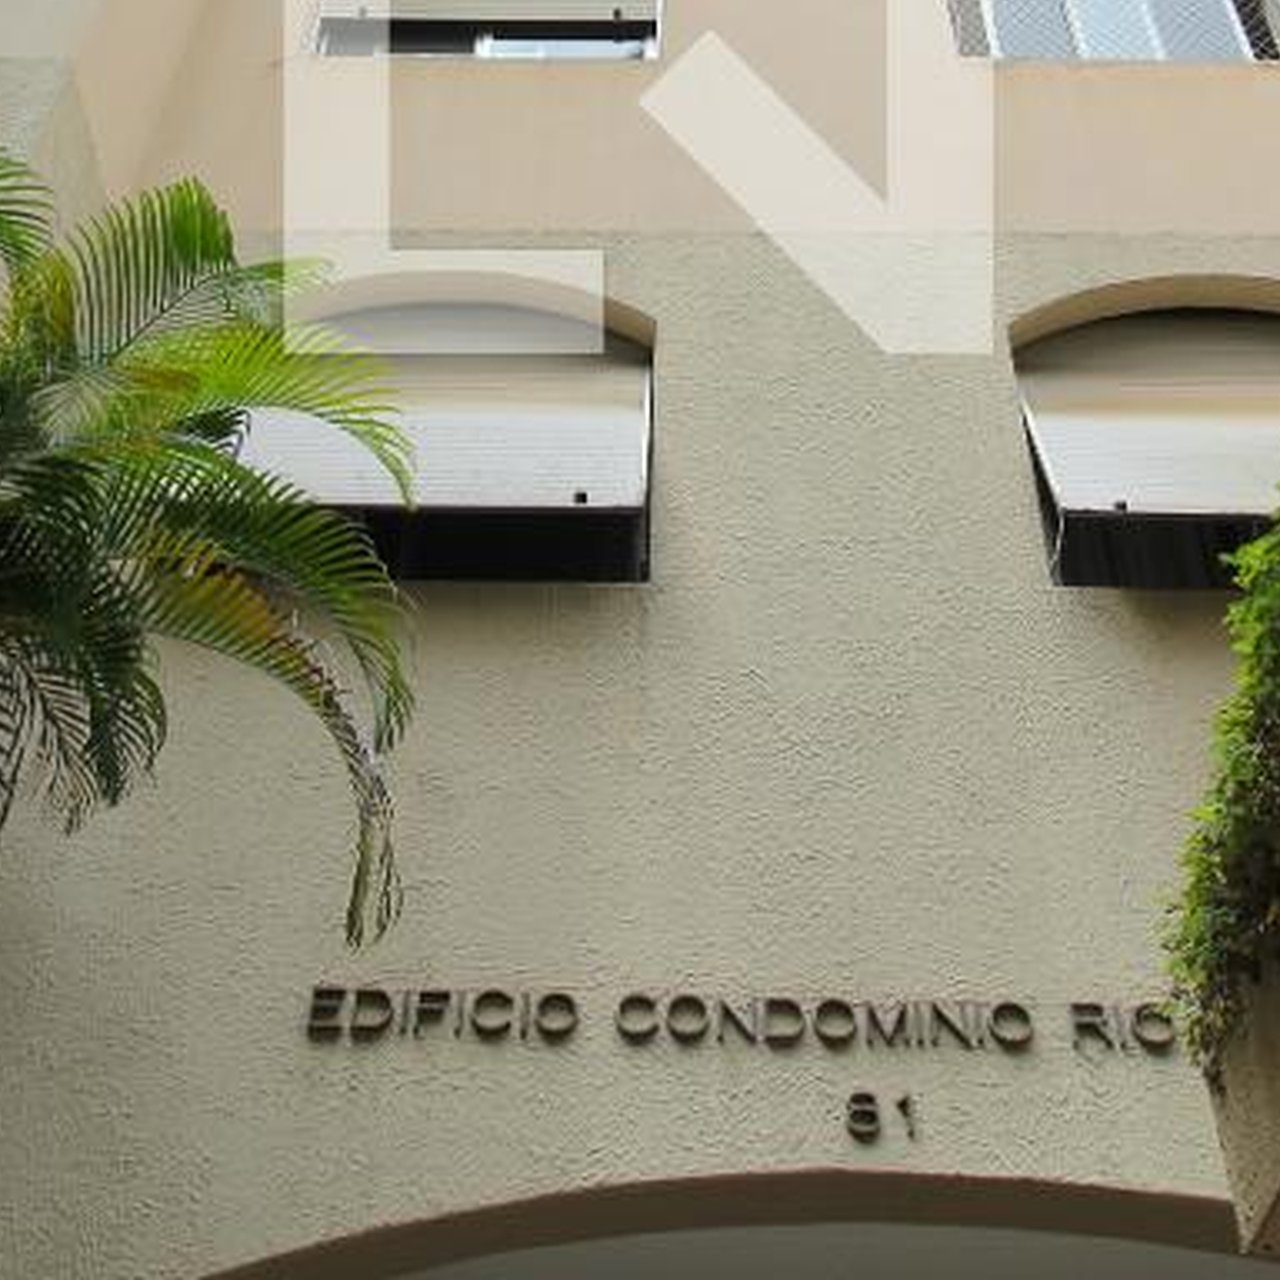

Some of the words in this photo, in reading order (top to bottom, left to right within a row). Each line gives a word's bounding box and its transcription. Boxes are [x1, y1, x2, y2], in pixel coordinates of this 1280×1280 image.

[307, 987, 579, 1044] EDIFICIO
[615, 991, 1034, 1050] CONDOMINIO
[1069, 999, 1176, 1054] RIO
